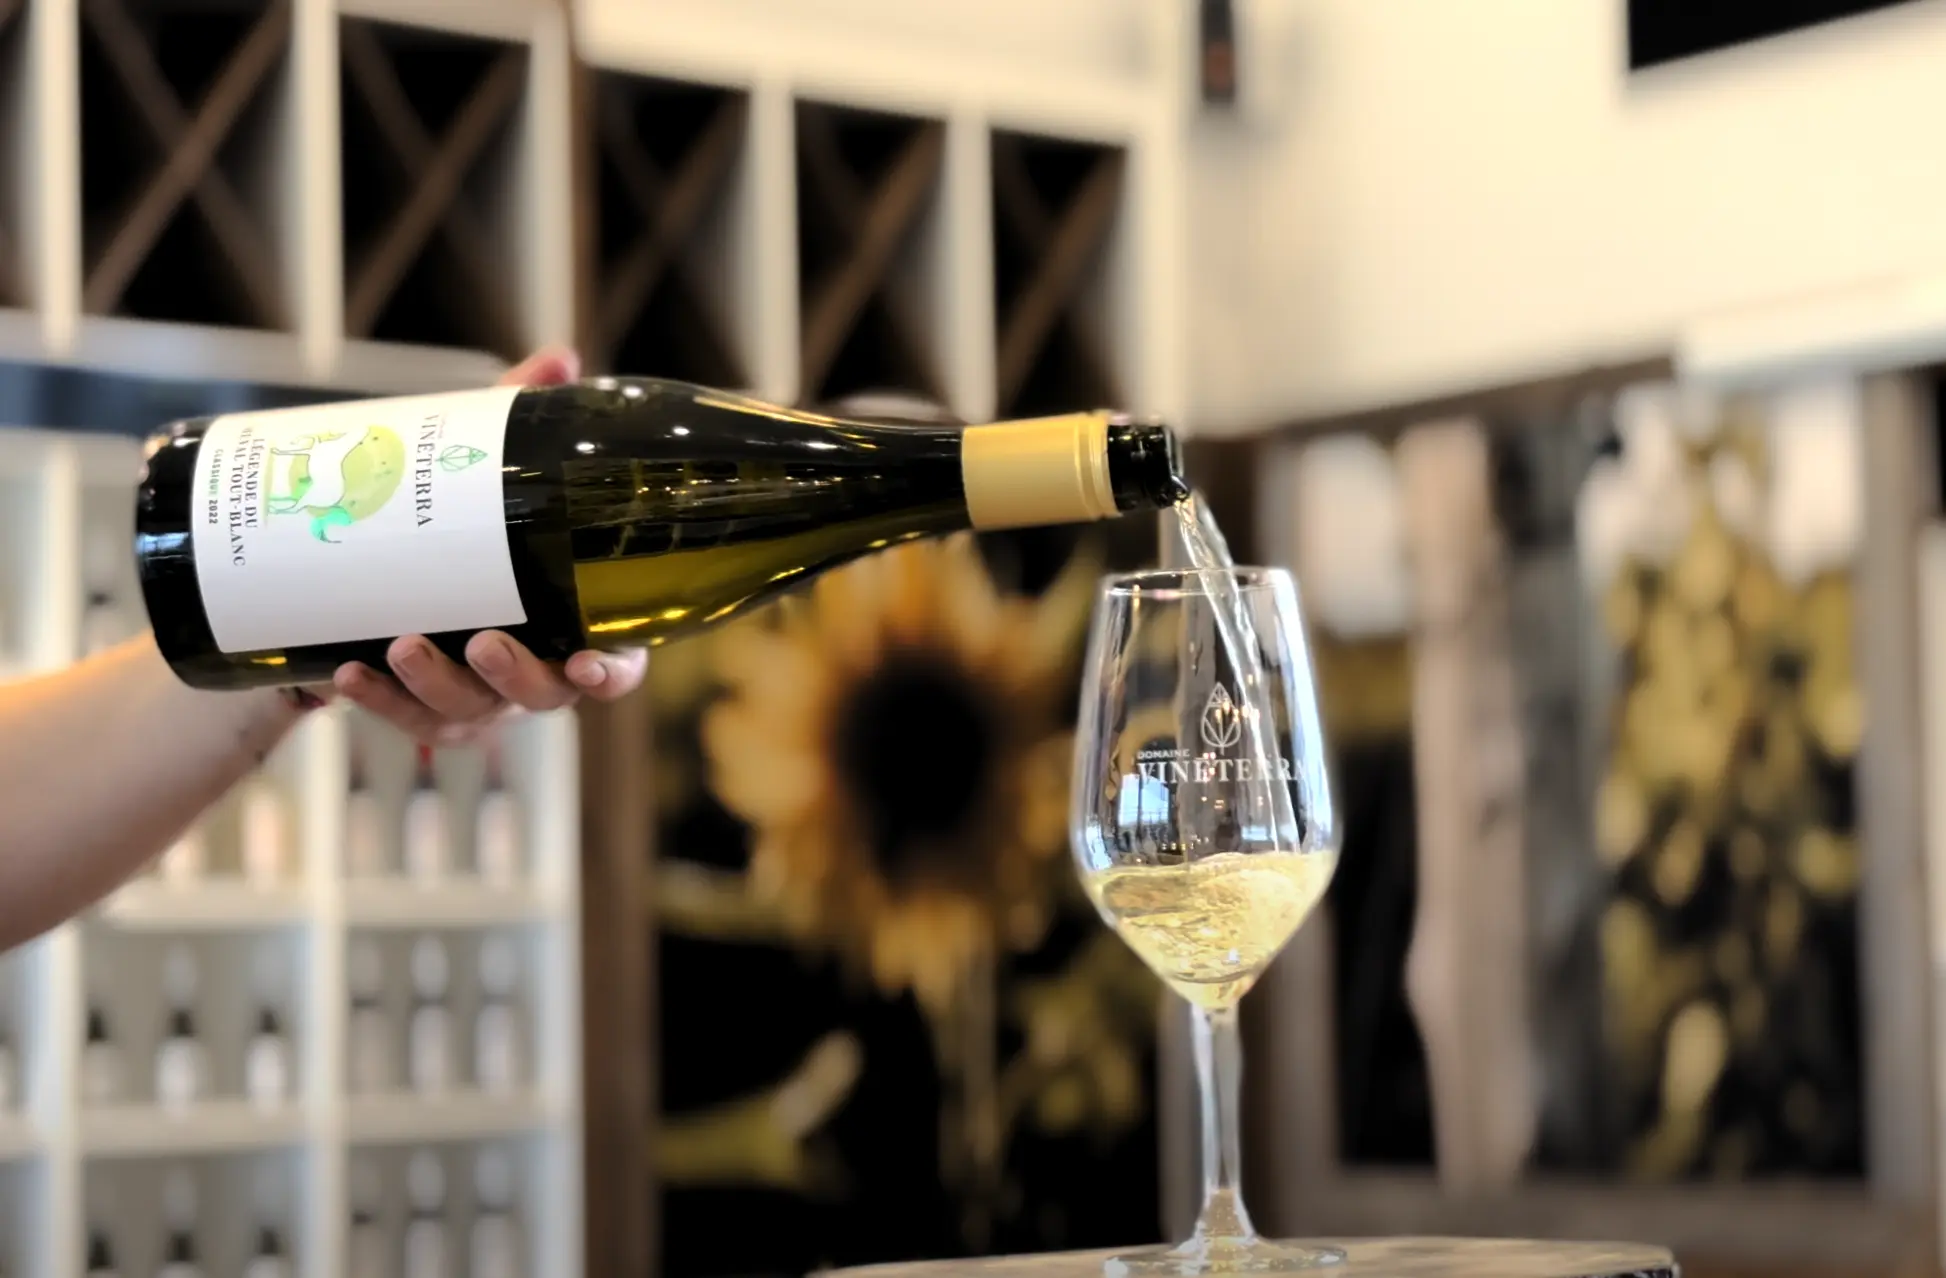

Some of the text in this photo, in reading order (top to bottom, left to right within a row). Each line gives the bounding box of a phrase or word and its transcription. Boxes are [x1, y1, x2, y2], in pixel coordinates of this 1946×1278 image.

[208, 499, 219, 525] 2022
[229, 464, 246, 567] TOUT-BLANC
[245, 506, 258, 528] DU
[1137, 748, 1190, 760] DOMAINE
